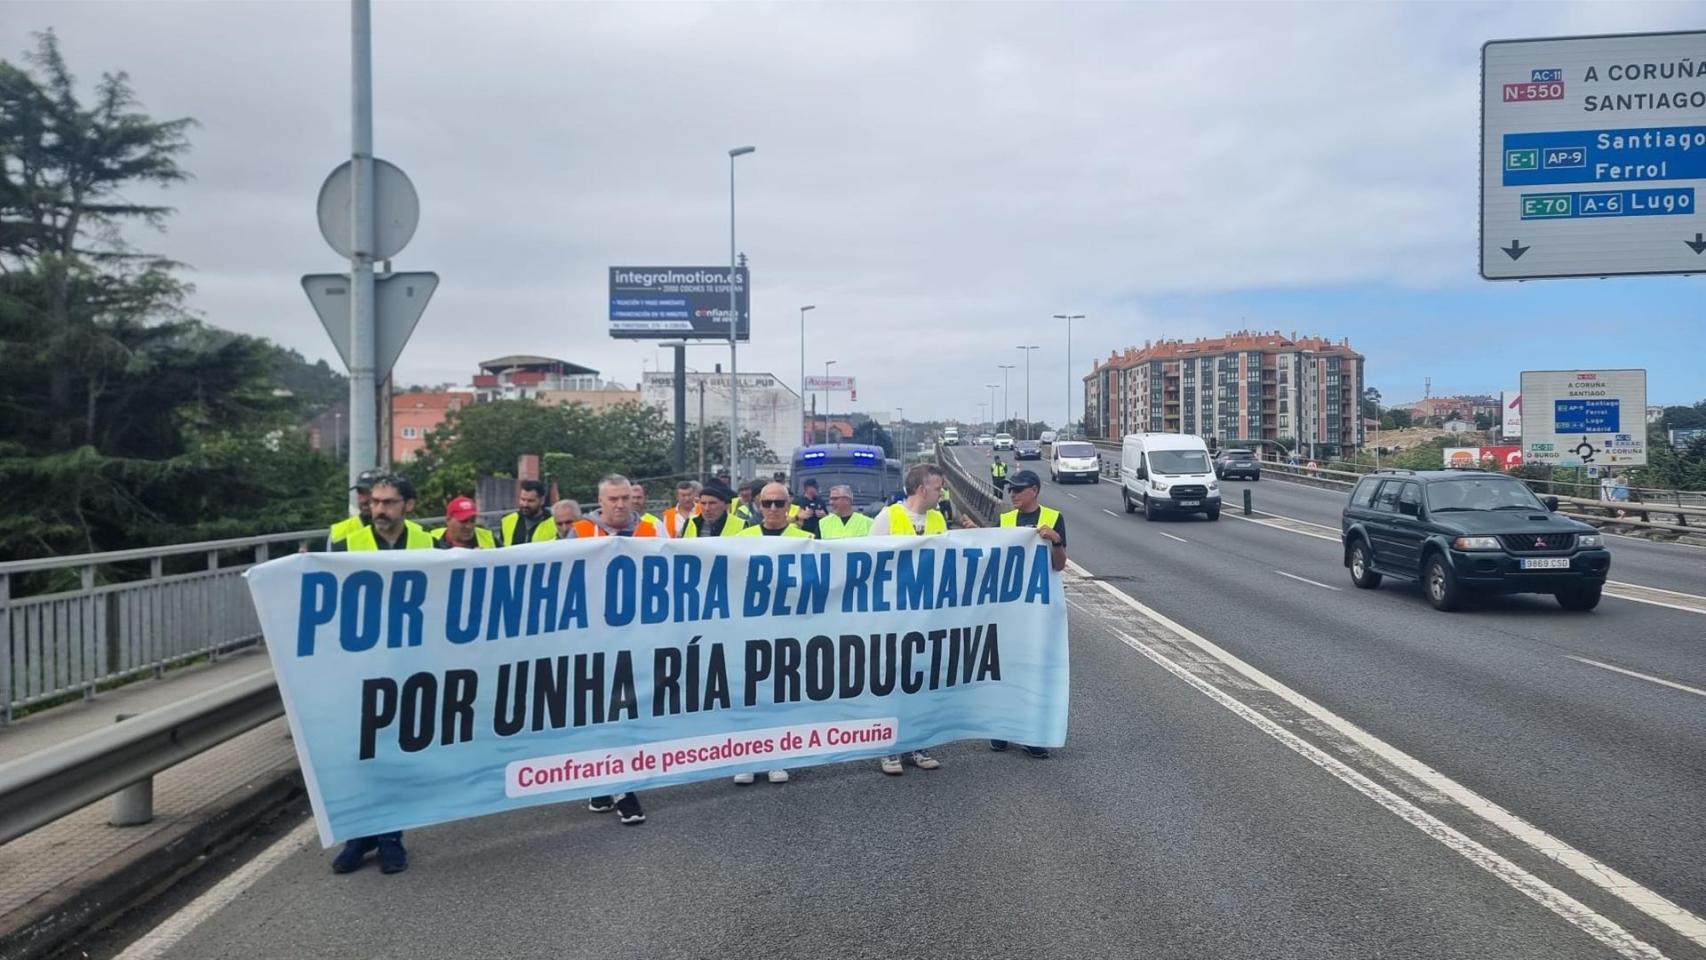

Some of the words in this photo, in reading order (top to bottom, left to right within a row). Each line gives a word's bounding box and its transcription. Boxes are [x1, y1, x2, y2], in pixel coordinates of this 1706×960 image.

[1532, 70, 1562, 82] AC-11
[1584, 66, 1599, 82] A
[1609, 58, 1706, 81] CORUÑA
[1505, 84, 1562, 100] N-550
[1584, 91, 1706, 112] SANTIAGO
[1597, 132, 1706, 151] Santiago
[1509, 152, 1536, 167] E-1
[1548, 151, 1583, 165] AP-9
[1595, 161, 1667, 180] Ferrol
[1525, 199, 1568, 214] E-70
[1584, 197, 1619, 212] A-6
[1631, 192, 1690, 213] Lugo
[615, 270, 743, 286] integralmotion.es
[715, 285, 743, 293] ESPEAN
[1586, 417, 1604, 425] Lugo
[297, 569, 428, 658] POR
[445, 559, 589, 645] UNHA
[604, 554, 730, 628] OBRA
[743, 552, 831, 618] BEN
[841, 544, 1051, 614] REMATADA
[359, 668, 479, 761] POR
[493, 650, 639, 737] UNHA
[652, 635, 731, 717] RÍA
[743, 623, 1002, 707] PRODUCTIVA
[517, 754, 625, 788] Confraría
[631, 750, 657, 772] de
[662, 734, 774, 772] pescadores
[779, 731, 802, 752] de
[808, 728, 822, 748] A
[827, 722, 893, 746] Coruña
